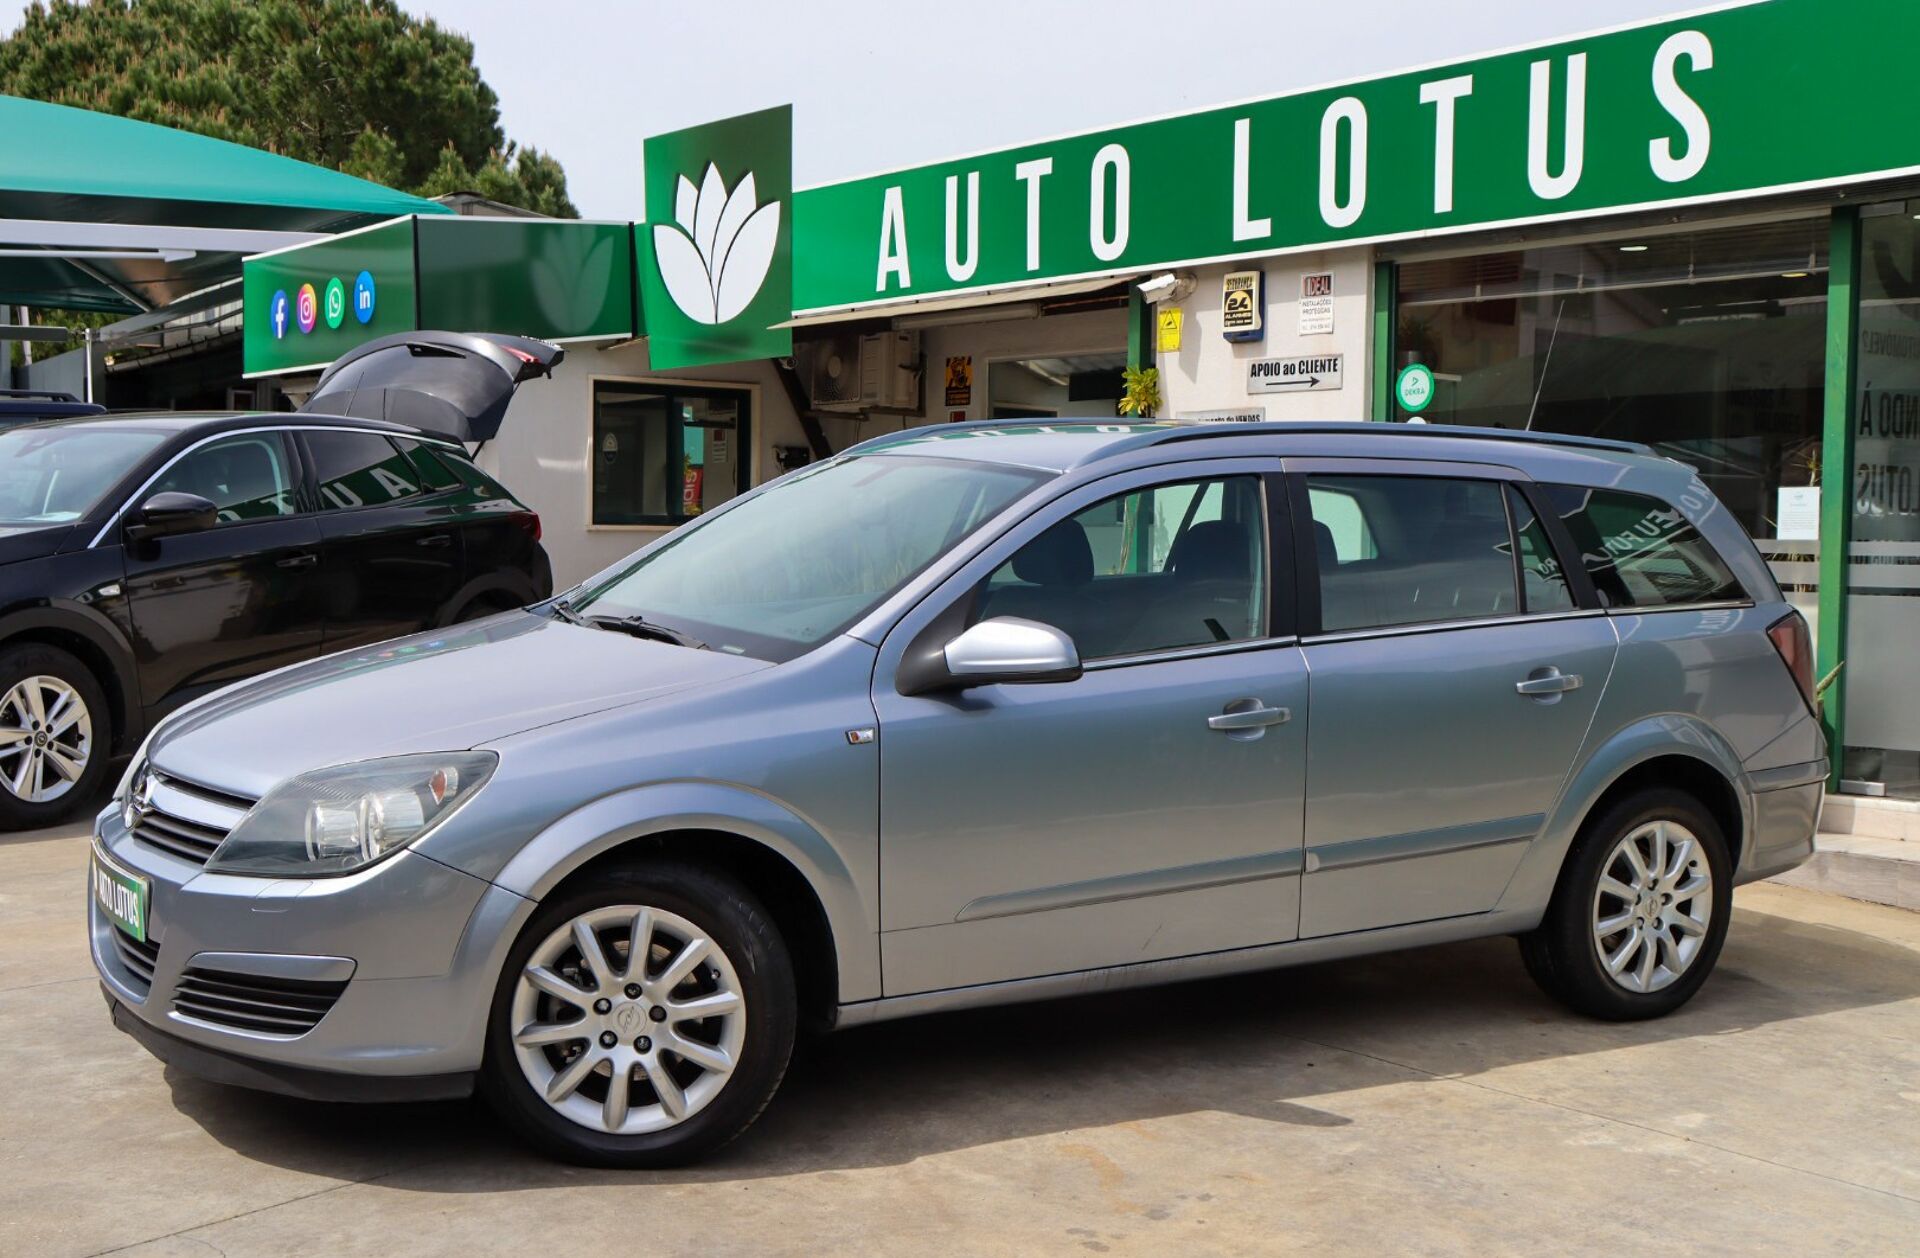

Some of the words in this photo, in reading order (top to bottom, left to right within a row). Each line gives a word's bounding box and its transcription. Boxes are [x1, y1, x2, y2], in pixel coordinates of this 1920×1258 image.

[875, 142, 1132, 292] AUTO
[1232, 30, 1714, 243] LOTUS
[1307, 276, 1331, 297] IDEAL
[1228, 297, 1249, 311] 24
[1250, 362, 1281, 378] APOIO
[1283, 363, 1296, 376] ao
[1298, 358, 1338, 375] CLIENTE
[112, 879, 140, 929] LOTUS
